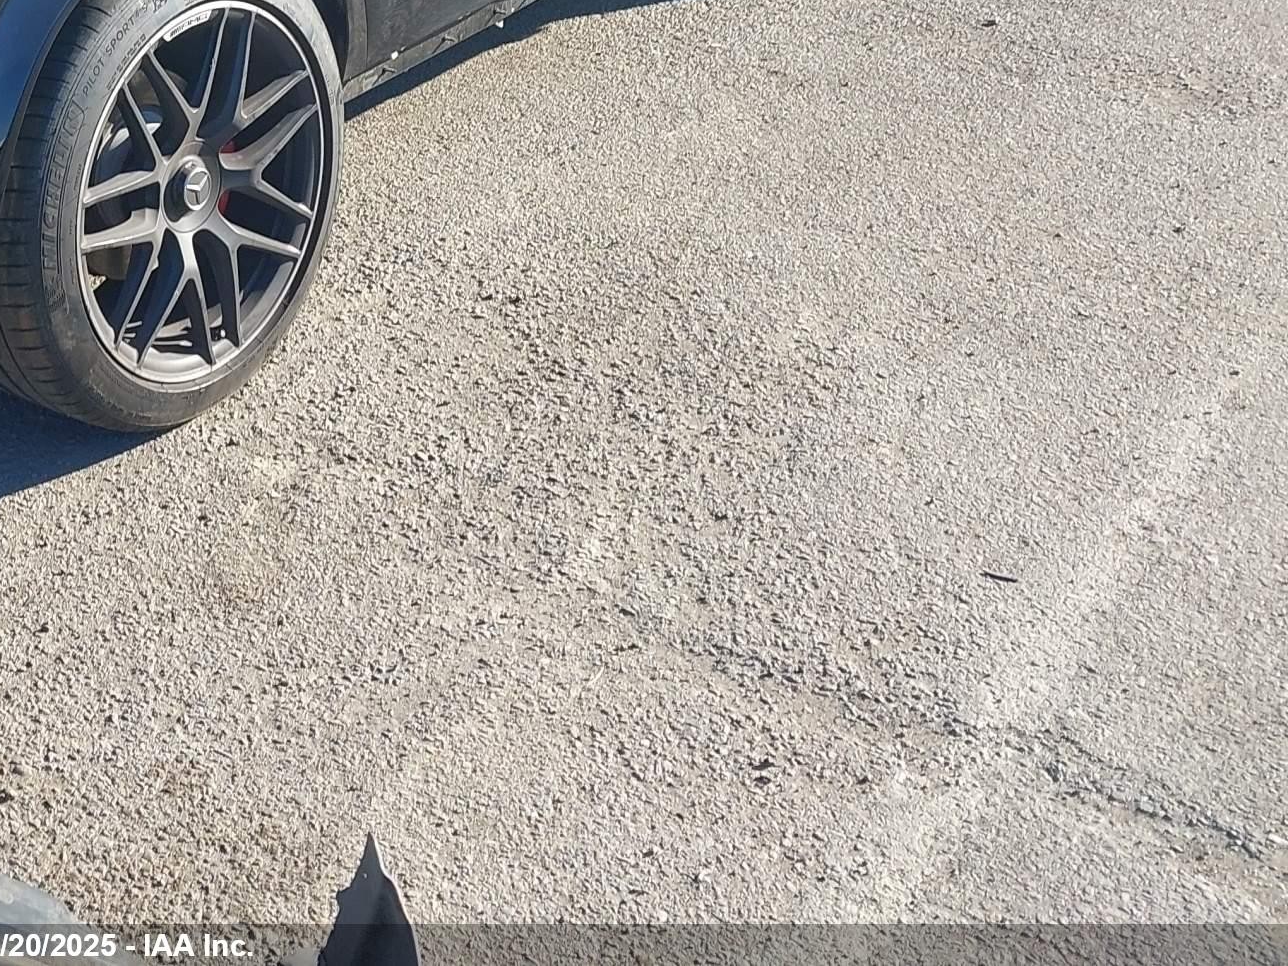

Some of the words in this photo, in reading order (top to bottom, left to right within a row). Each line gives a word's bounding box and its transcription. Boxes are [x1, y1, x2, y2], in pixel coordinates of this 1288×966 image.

[82, 56, 106, 97] PILOT
[105, 15, 136, 56] SPORT
[43, 105, 82, 271] MICHELIN
